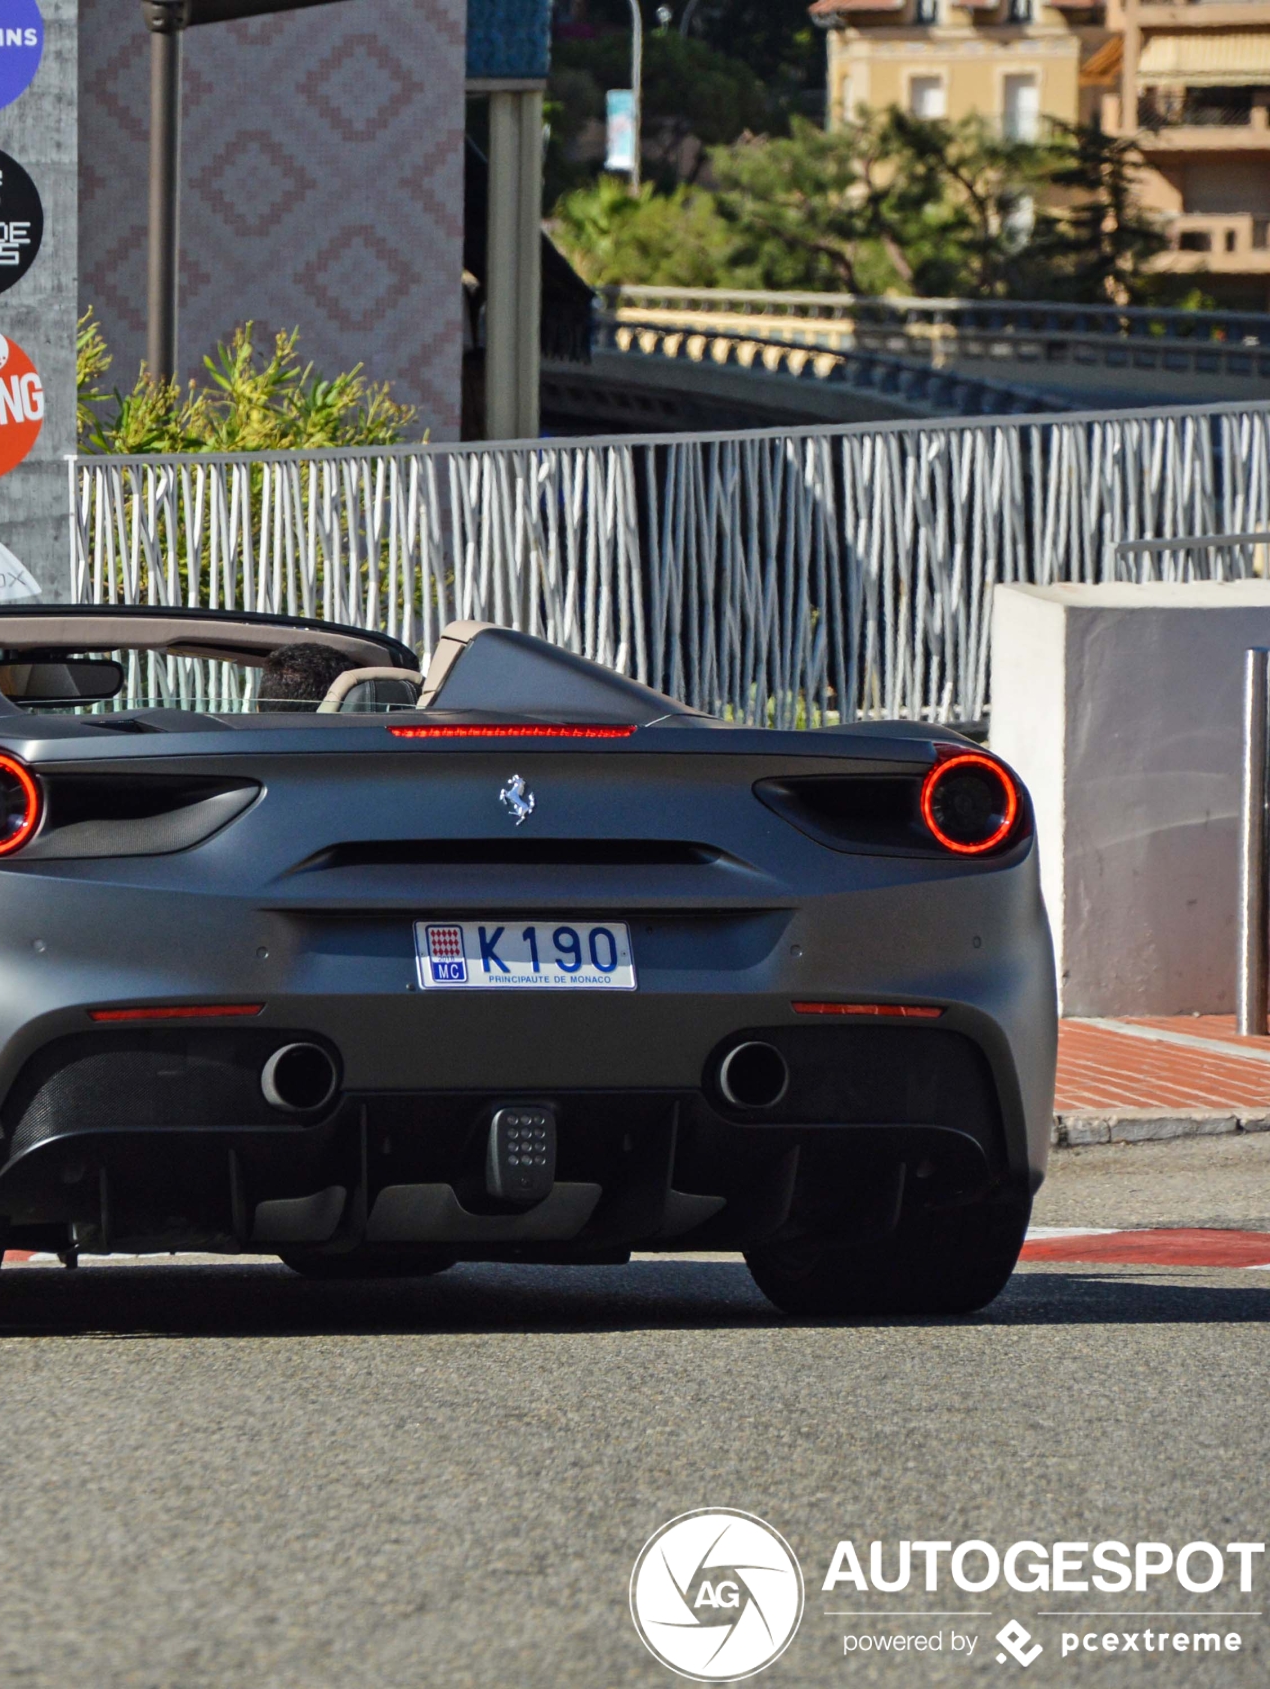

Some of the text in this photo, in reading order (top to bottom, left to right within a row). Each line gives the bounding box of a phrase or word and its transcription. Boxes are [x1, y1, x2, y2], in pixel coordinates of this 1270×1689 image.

[438, 964, 460, 979] MC
[489, 975, 612, 985] PRINCIPAUTE DE MONACO
